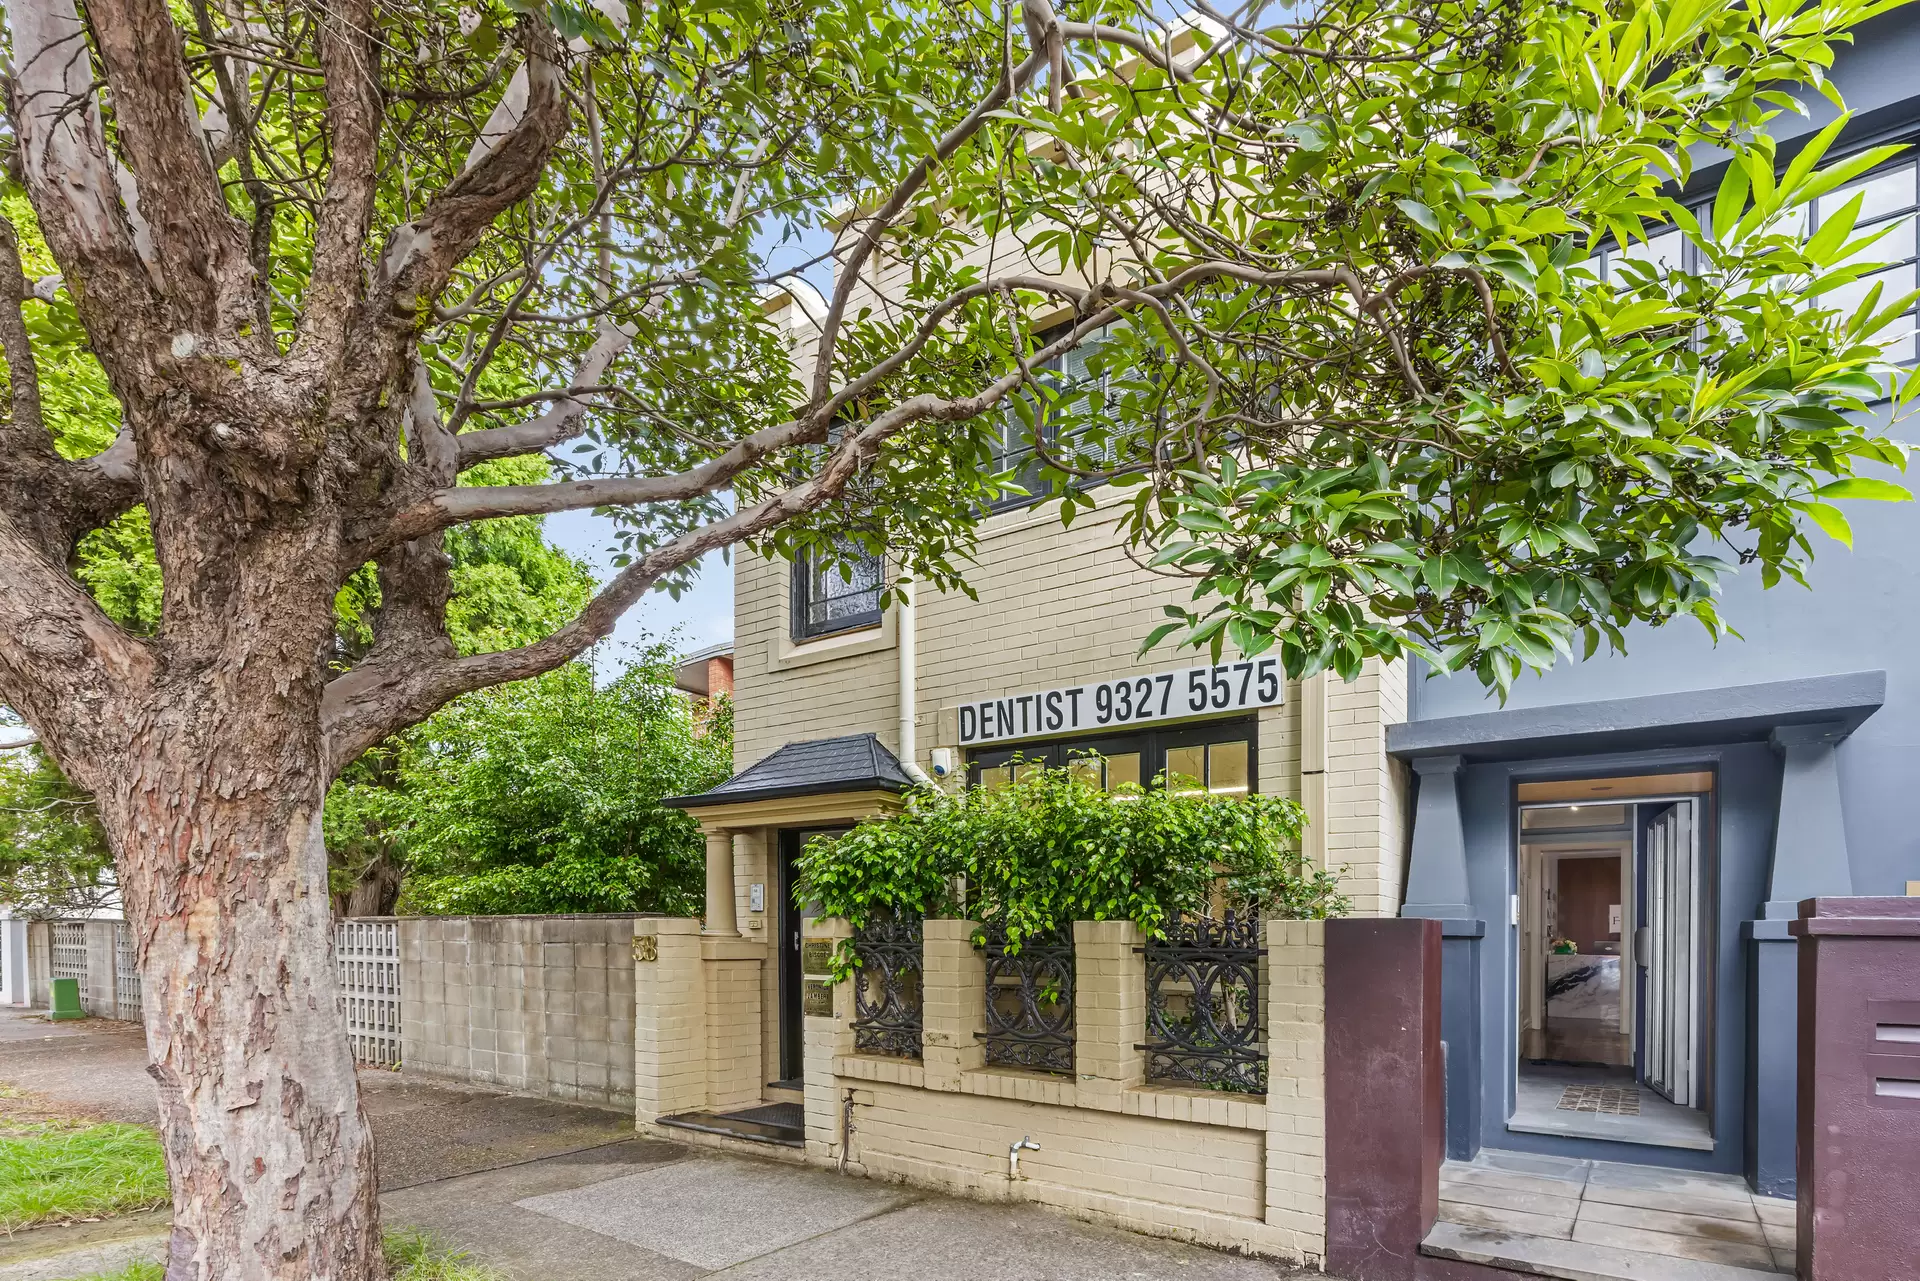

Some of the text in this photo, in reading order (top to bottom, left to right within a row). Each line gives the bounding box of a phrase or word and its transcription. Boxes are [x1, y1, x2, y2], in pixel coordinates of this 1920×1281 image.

[960, 659, 1278, 742] DENTIST 9327 5575
[632, 936, 657, 961] 58
